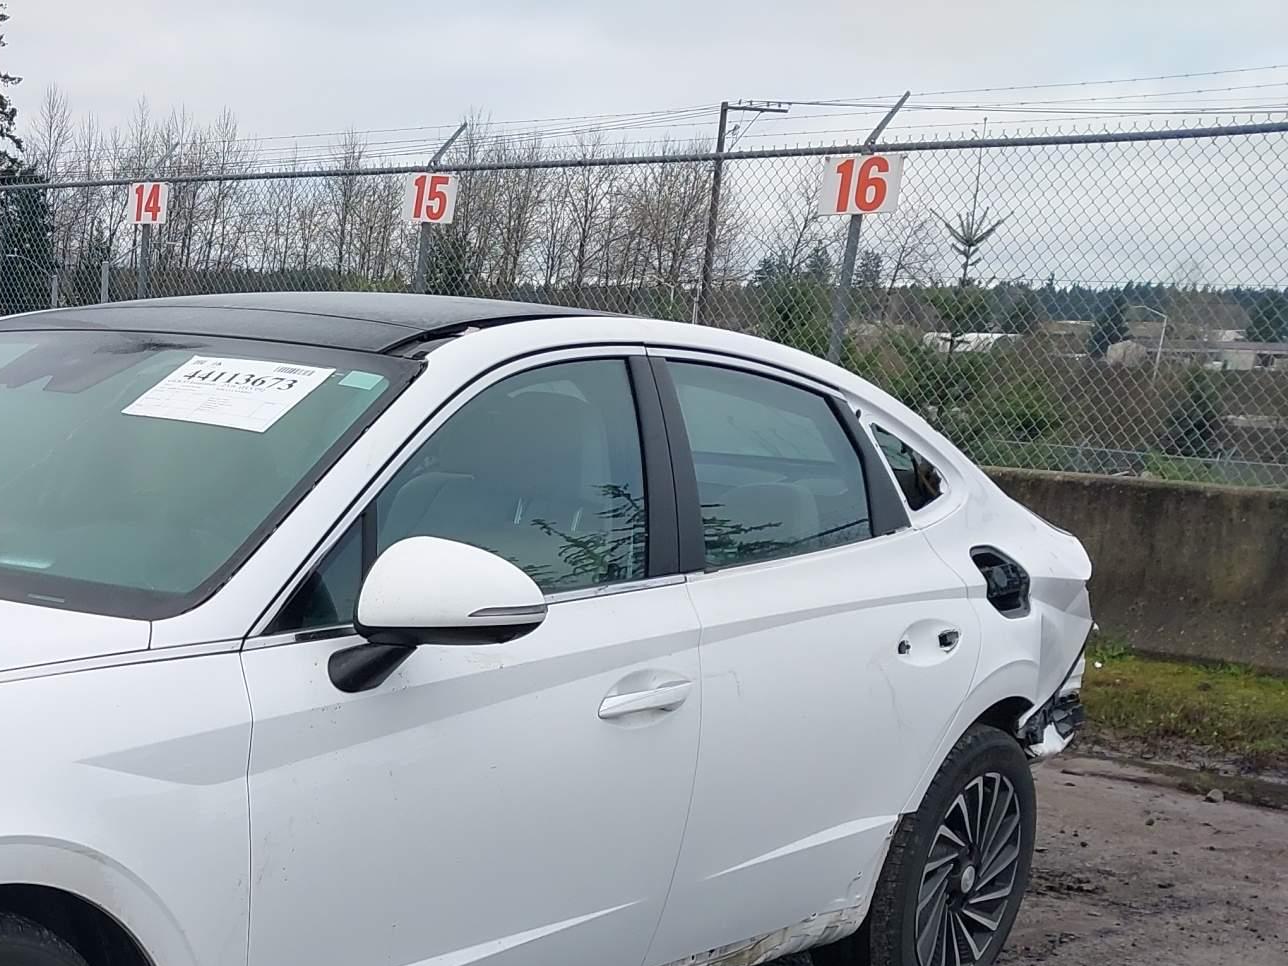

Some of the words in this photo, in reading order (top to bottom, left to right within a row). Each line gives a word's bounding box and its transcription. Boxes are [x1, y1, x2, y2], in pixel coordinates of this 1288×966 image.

[134, 183, 161, 222] 14
[413, 175, 449, 220] 15
[835, 156, 889, 212] 16
[183, 368, 299, 392] 44113673
